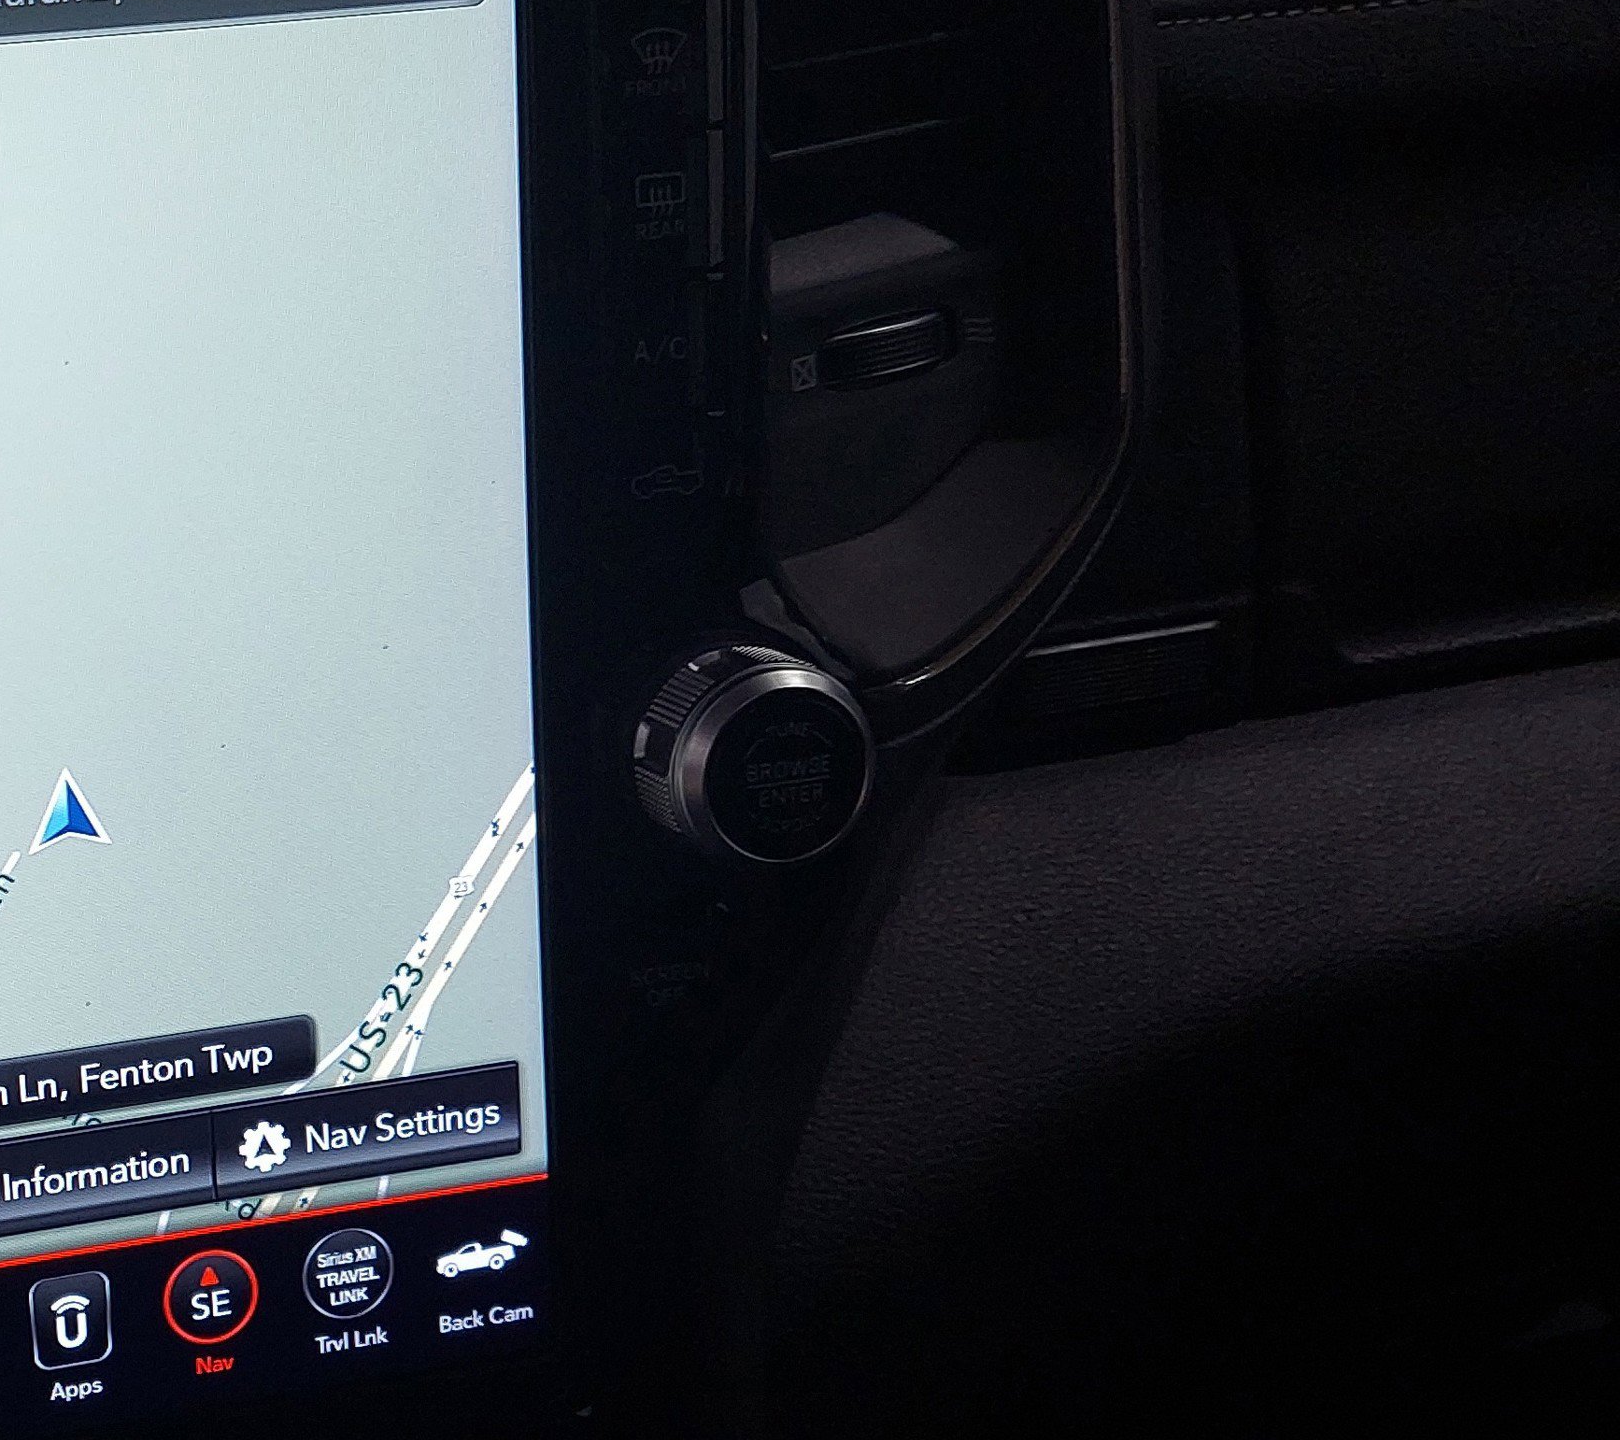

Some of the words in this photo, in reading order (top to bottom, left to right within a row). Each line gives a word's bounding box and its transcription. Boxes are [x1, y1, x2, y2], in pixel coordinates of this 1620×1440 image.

[340, 962, 424, 1076] US-23
[19, 1071, 68, 1103] Ln,
[81, 1055, 195, 1095] Fenton
[201, 1043, 274, 1076] Twp
[305, 1117, 367, 1154] Nav
[375, 1102, 501, 1145] Settings
[3, 1150, 191, 1203] Information
[316, 1251, 354, 1269] Sirius
[354, 1245, 377, 1262] XM
[316, 1266, 381, 1289] TRAVEL
[190, 1288, 233, 1321] SE
[329, 1286, 370, 1307] LINK
[438, 1312, 484, 1334] Back
[488, 1303, 534, 1326] Cam
[315, 1332, 350, 1354] Trvl
[353, 1326, 389, 1348] Lnk
[194, 1354, 235, 1376] Nav
[49, 1377, 104, 1402] Apps
